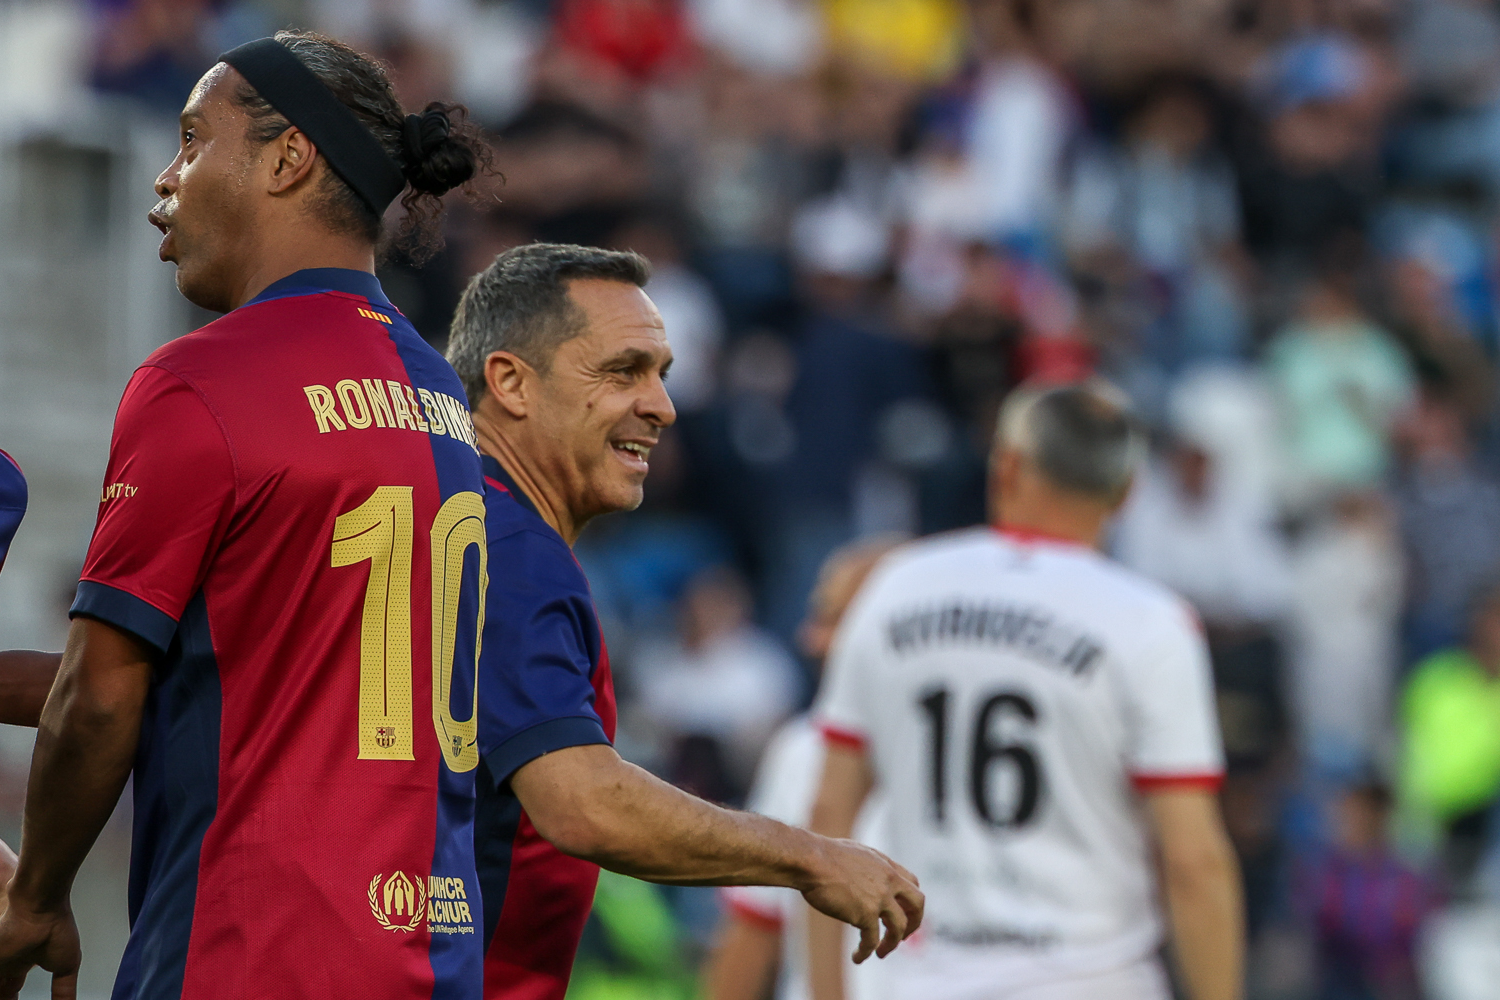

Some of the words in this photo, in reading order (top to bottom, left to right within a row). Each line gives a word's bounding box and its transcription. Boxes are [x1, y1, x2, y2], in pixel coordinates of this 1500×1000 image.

[330, 486, 490, 773] 10
[916, 688, 1043, 830] 16
[426, 900, 473, 924] ACNUR
[427, 876, 467, 900] UNHCR
